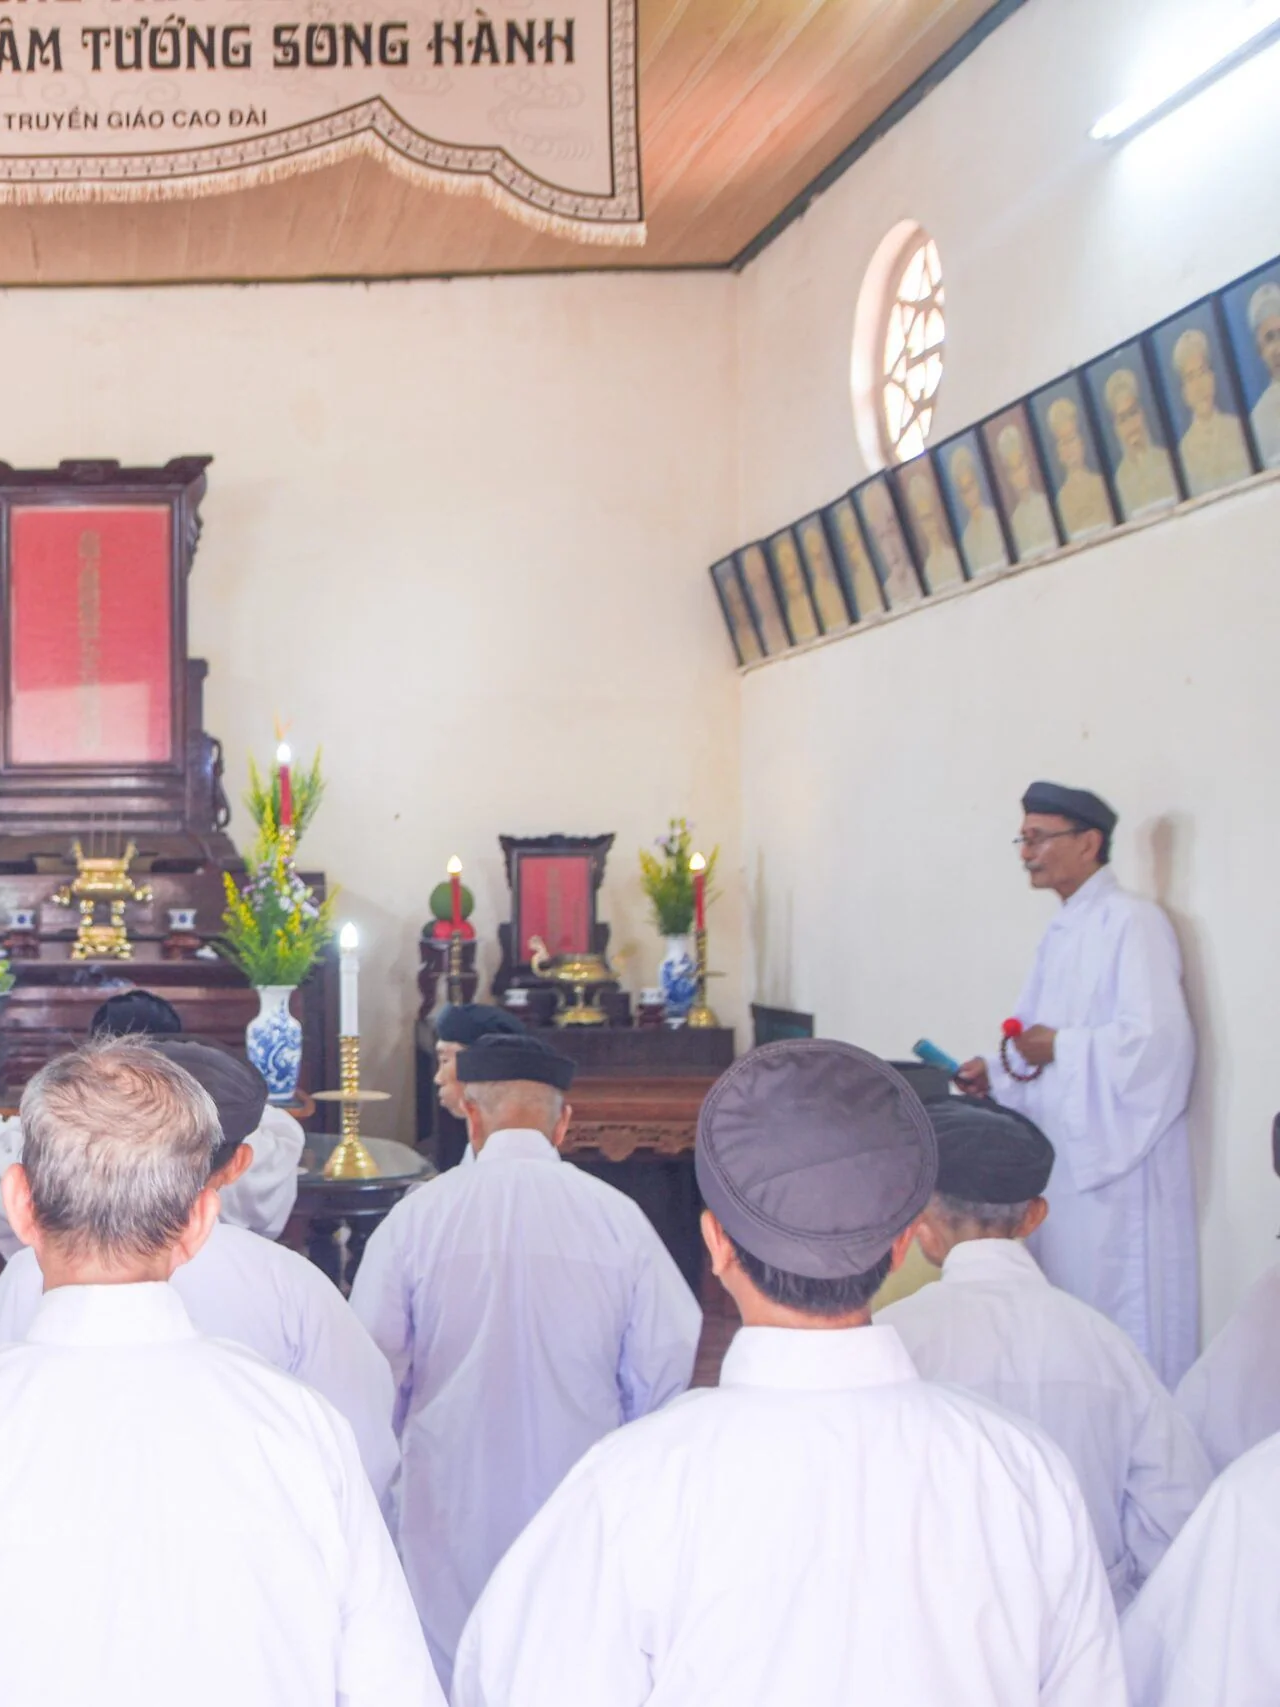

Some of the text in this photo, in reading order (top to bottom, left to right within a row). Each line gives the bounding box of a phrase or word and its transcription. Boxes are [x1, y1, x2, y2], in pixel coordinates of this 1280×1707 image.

[81, 13, 252, 71] TƯỚNG
[272, 22, 409, 69] SONG
[426, 8, 575, 67] HÀNH
[106, 106, 165, 130] GIÁO
[171, 109, 221, 128] CAO
[228, 104, 267, 127] ĐÀI
